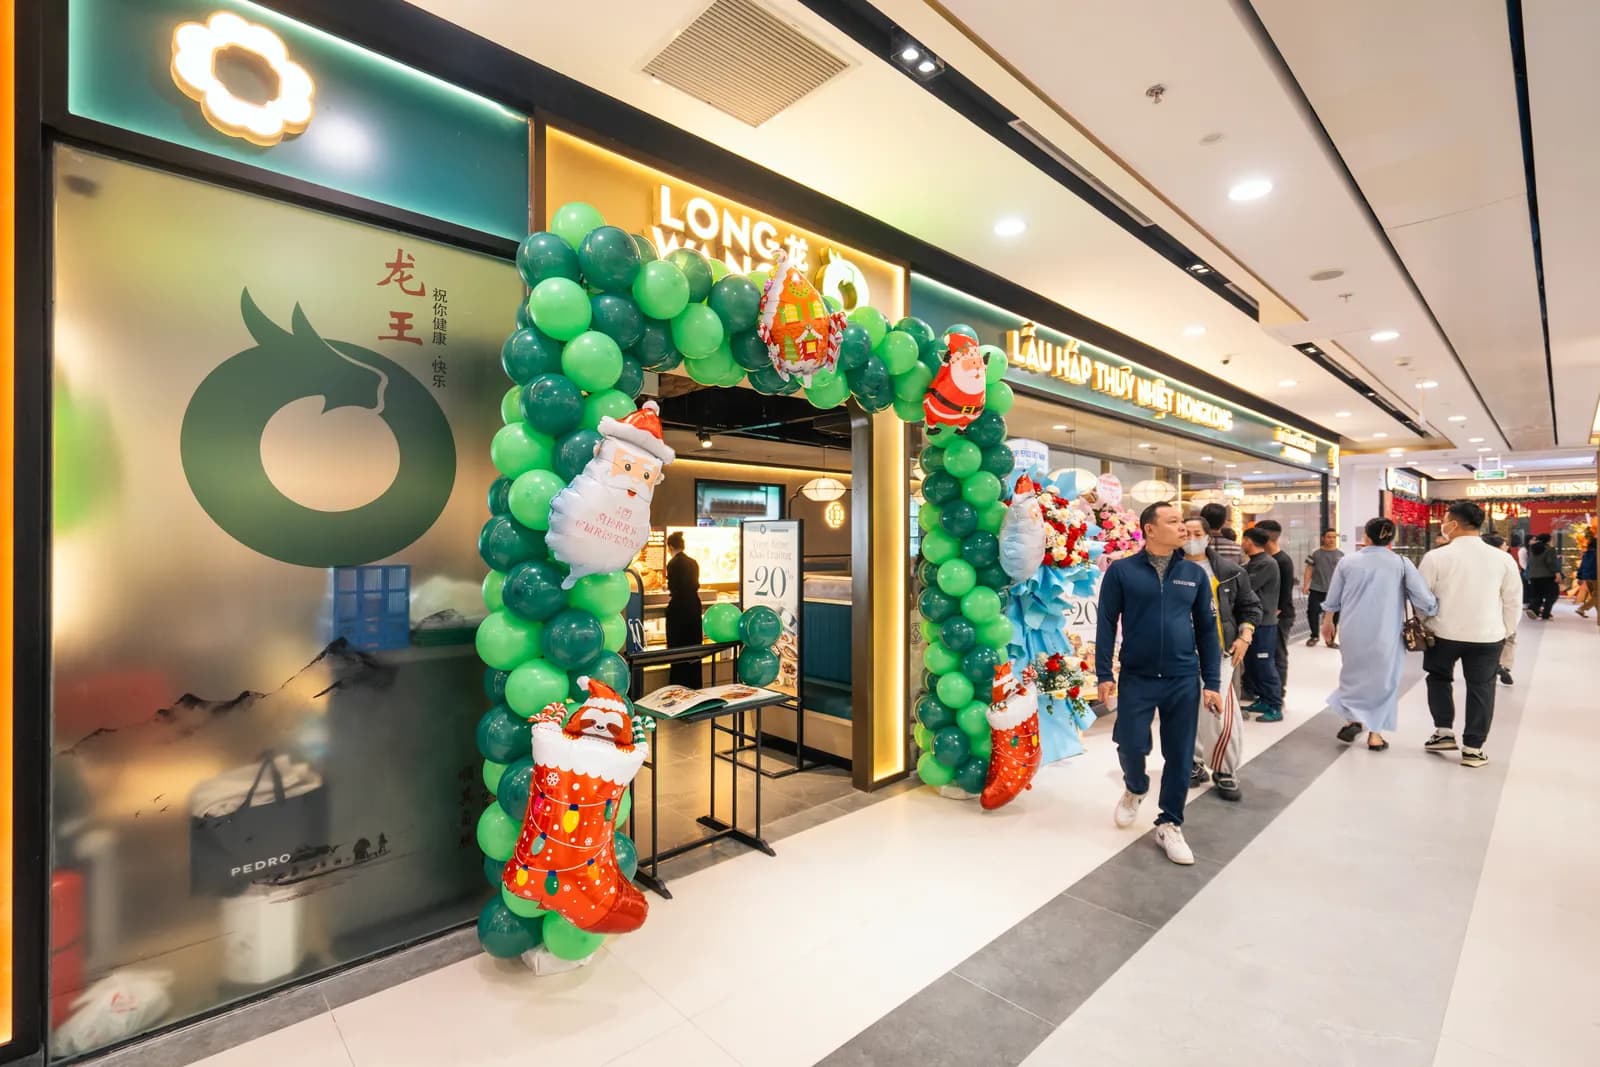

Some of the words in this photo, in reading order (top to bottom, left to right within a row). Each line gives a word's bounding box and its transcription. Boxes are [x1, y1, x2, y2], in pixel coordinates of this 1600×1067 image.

[660, 184, 780, 260] LONG
[376, 248, 426, 346] 龙王
[230, 853, 292, 877] PEDRO
